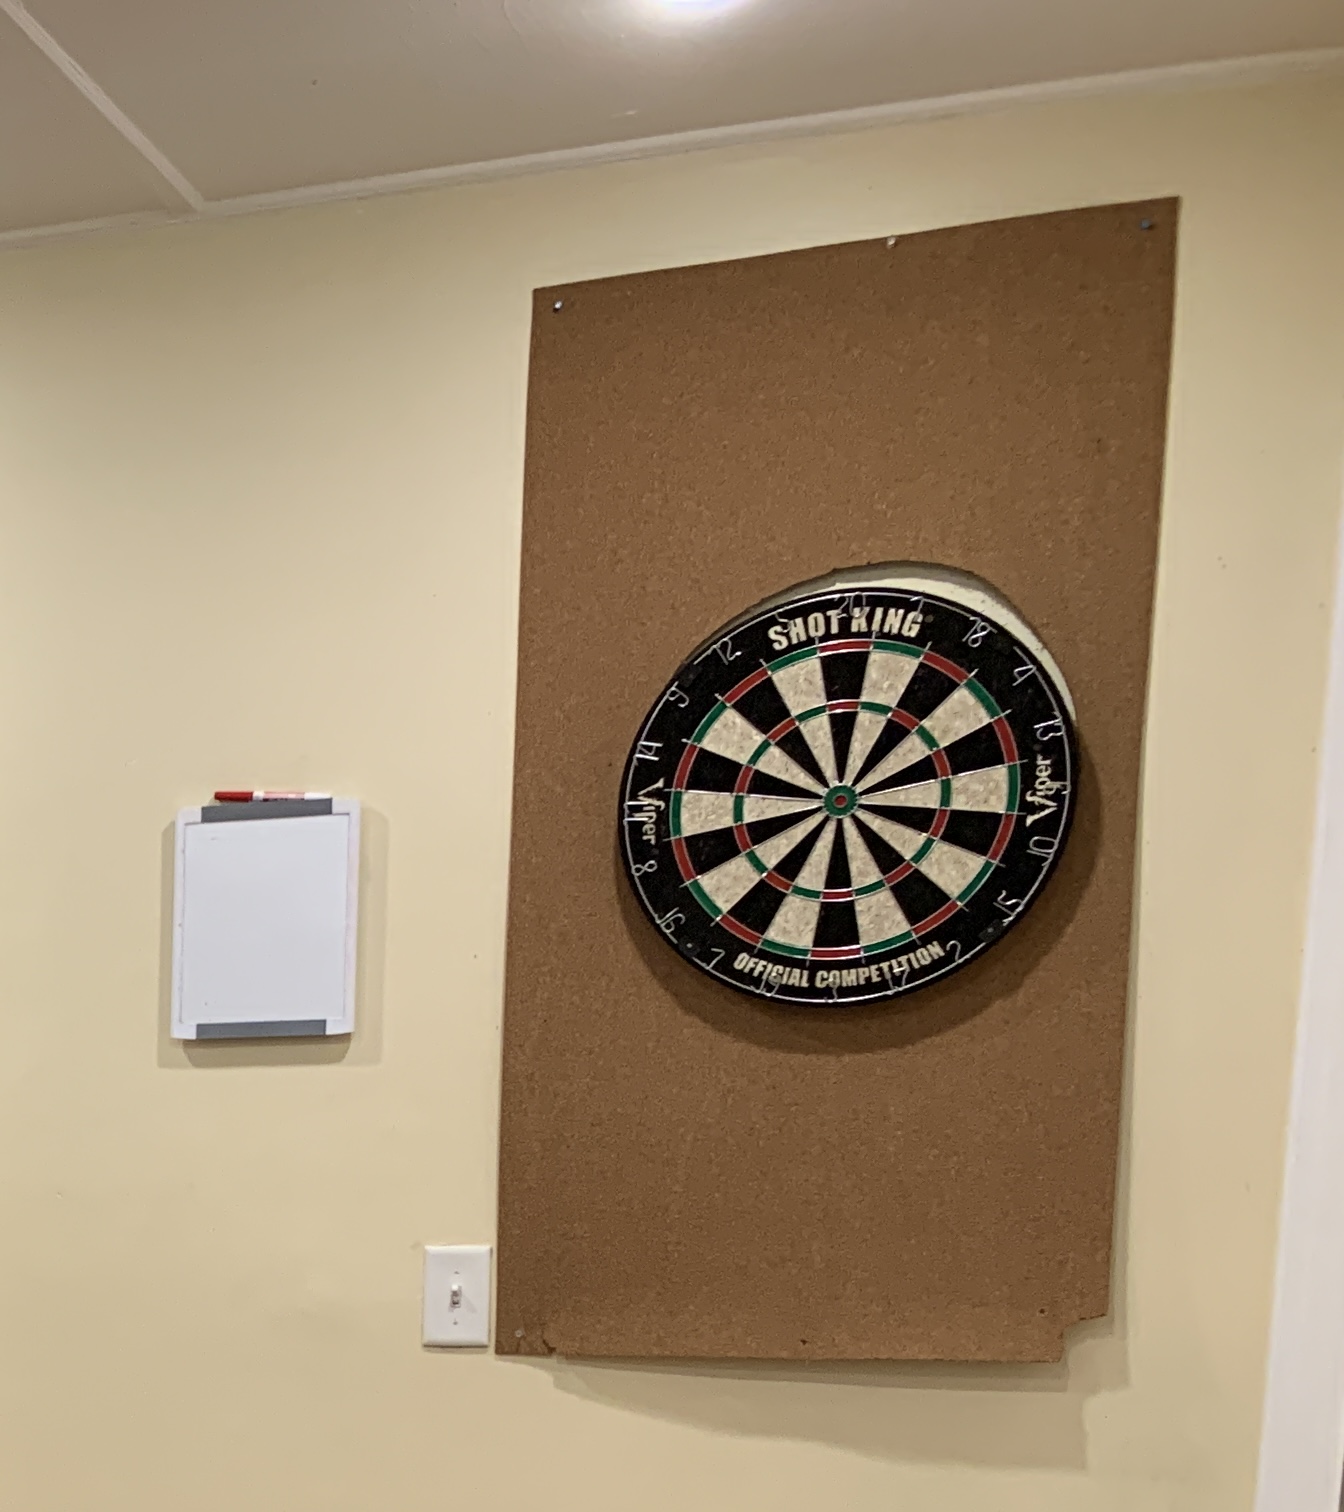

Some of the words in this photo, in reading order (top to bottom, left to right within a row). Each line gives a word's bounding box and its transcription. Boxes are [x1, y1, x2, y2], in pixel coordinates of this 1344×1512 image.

[767, 610, 842, 651] SHOT
[850, 606, 924, 638] KING
[636, 776, 666, 846] Viper
[1025, 753, 1058, 828] Viper
[733, 952, 811, 988] OFFICIAL
[814, 940, 946, 988] COMPETITION
